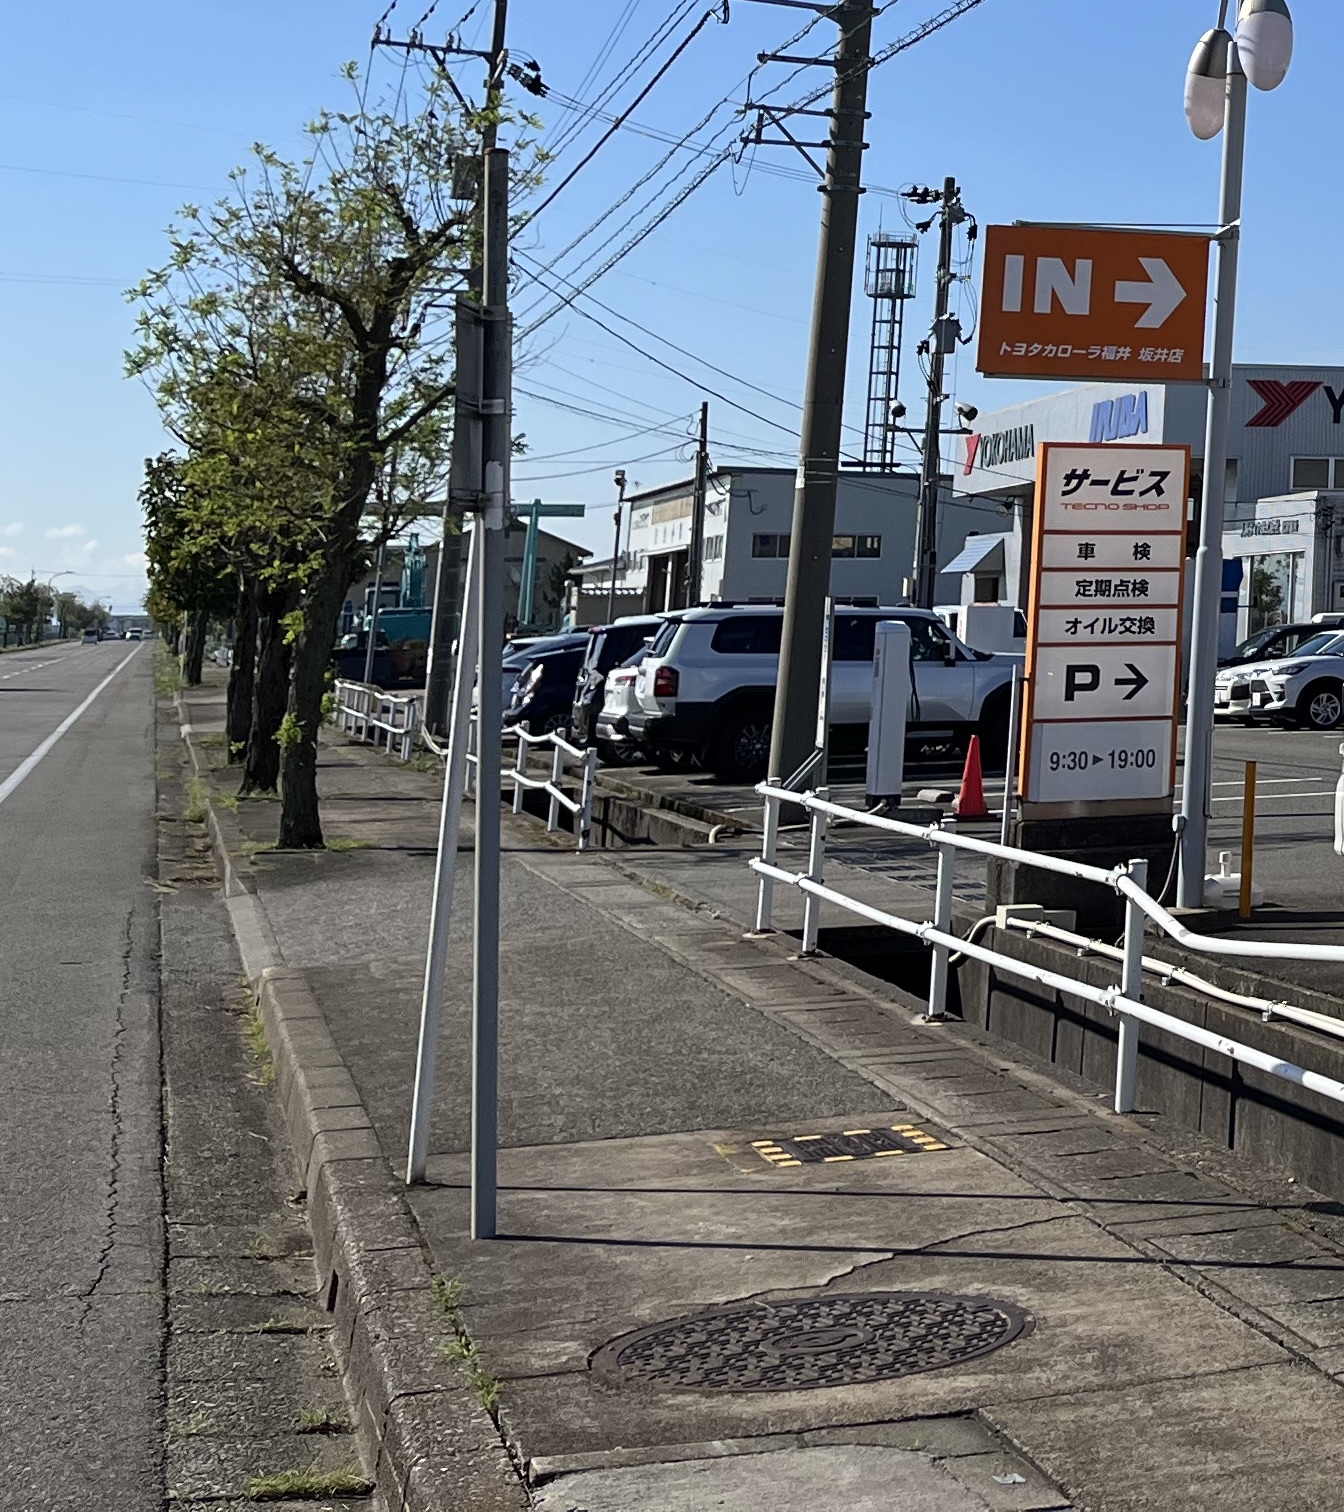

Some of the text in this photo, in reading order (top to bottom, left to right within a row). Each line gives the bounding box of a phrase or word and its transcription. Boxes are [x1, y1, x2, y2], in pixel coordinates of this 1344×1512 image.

[1002, 254, 1092, 315] IN
[1000, 341, 1184, 363] トヨタカローラ福井 坂井店
[980, 423, 1034, 468] YOKOHAMA
[1060, 468, 1170, 496] サービス
[1061, 502, 1169, 510] TECNO SHOP
[1075, 578, 1149, 597] 定期点検
[1064, 616, 1155, 635] オイル交換
[1064, 664, 1100, 701] P
[1050, 748, 1155, 770] 9:30 19:00
